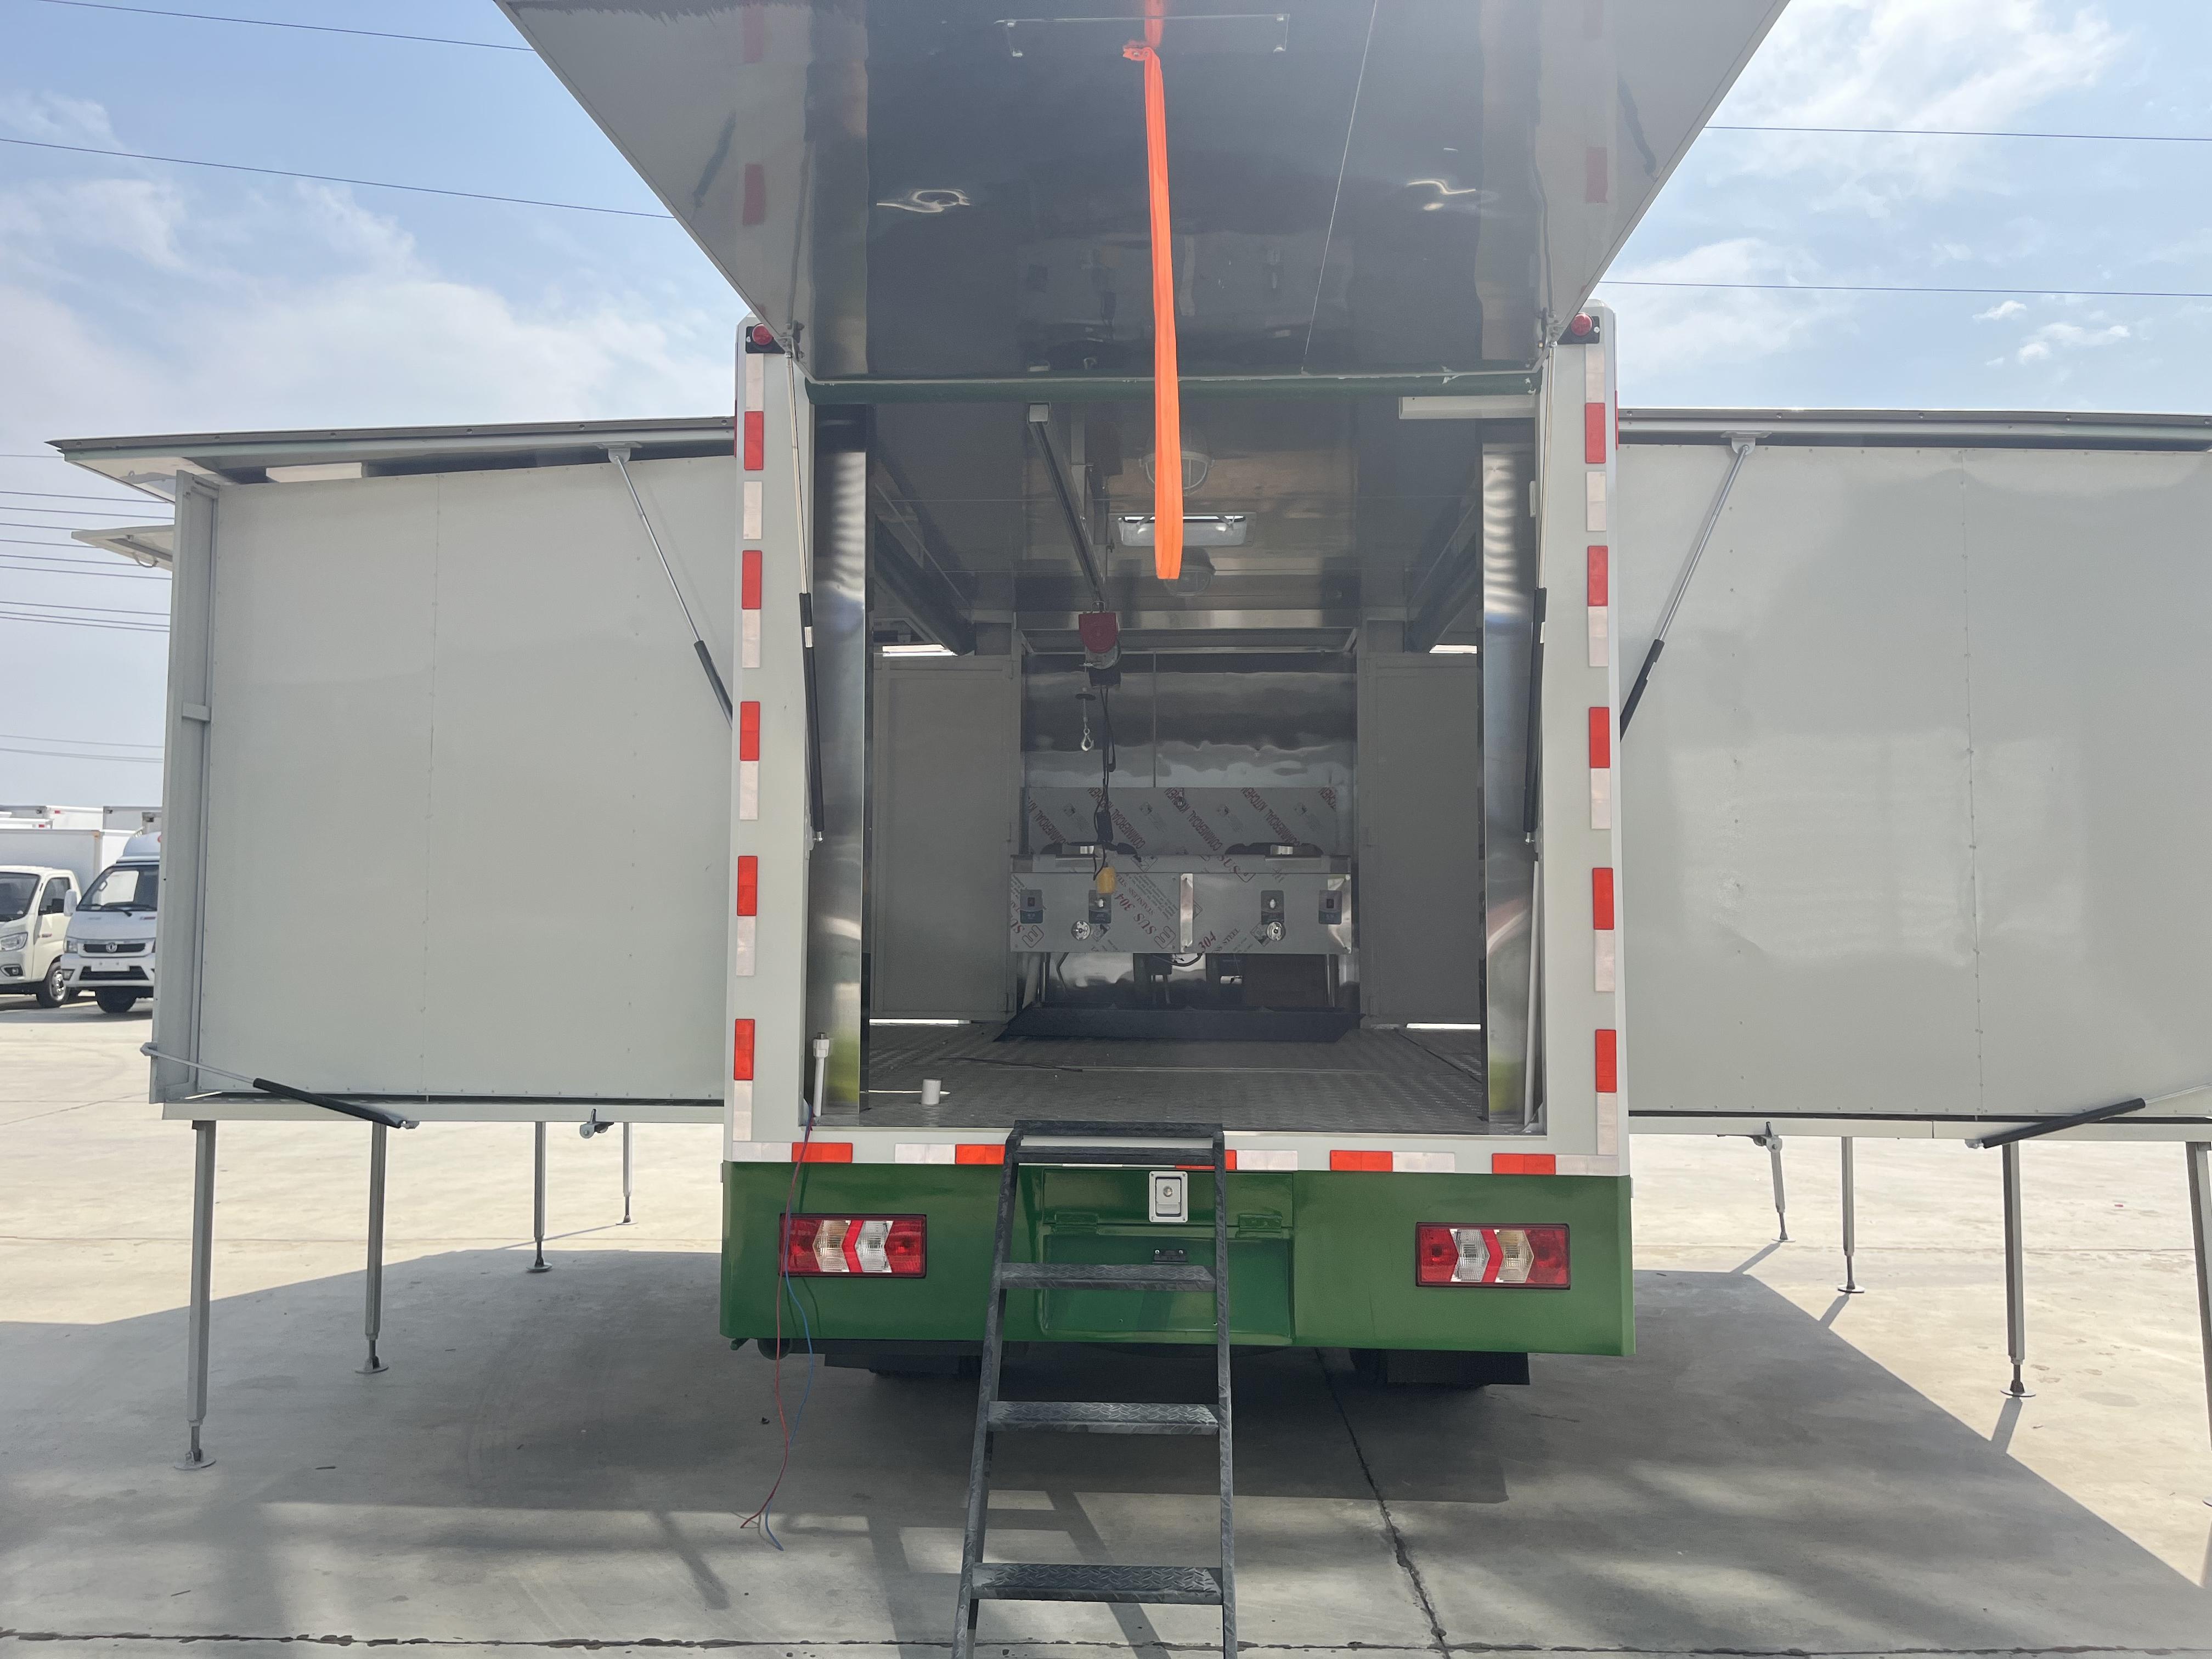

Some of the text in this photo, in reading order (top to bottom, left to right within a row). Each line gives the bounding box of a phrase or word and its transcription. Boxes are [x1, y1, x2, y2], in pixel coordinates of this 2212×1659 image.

[1111, 809, 1146, 849] COMMERCIAL
[1187, 810, 1223, 851] COMMERCIAL
[1114, 894, 1136, 911] 304
[1127, 887, 1155, 916] STAINLESS
[1133, 913, 1158, 935] SUS
[1198, 930, 1216, 953] 304
